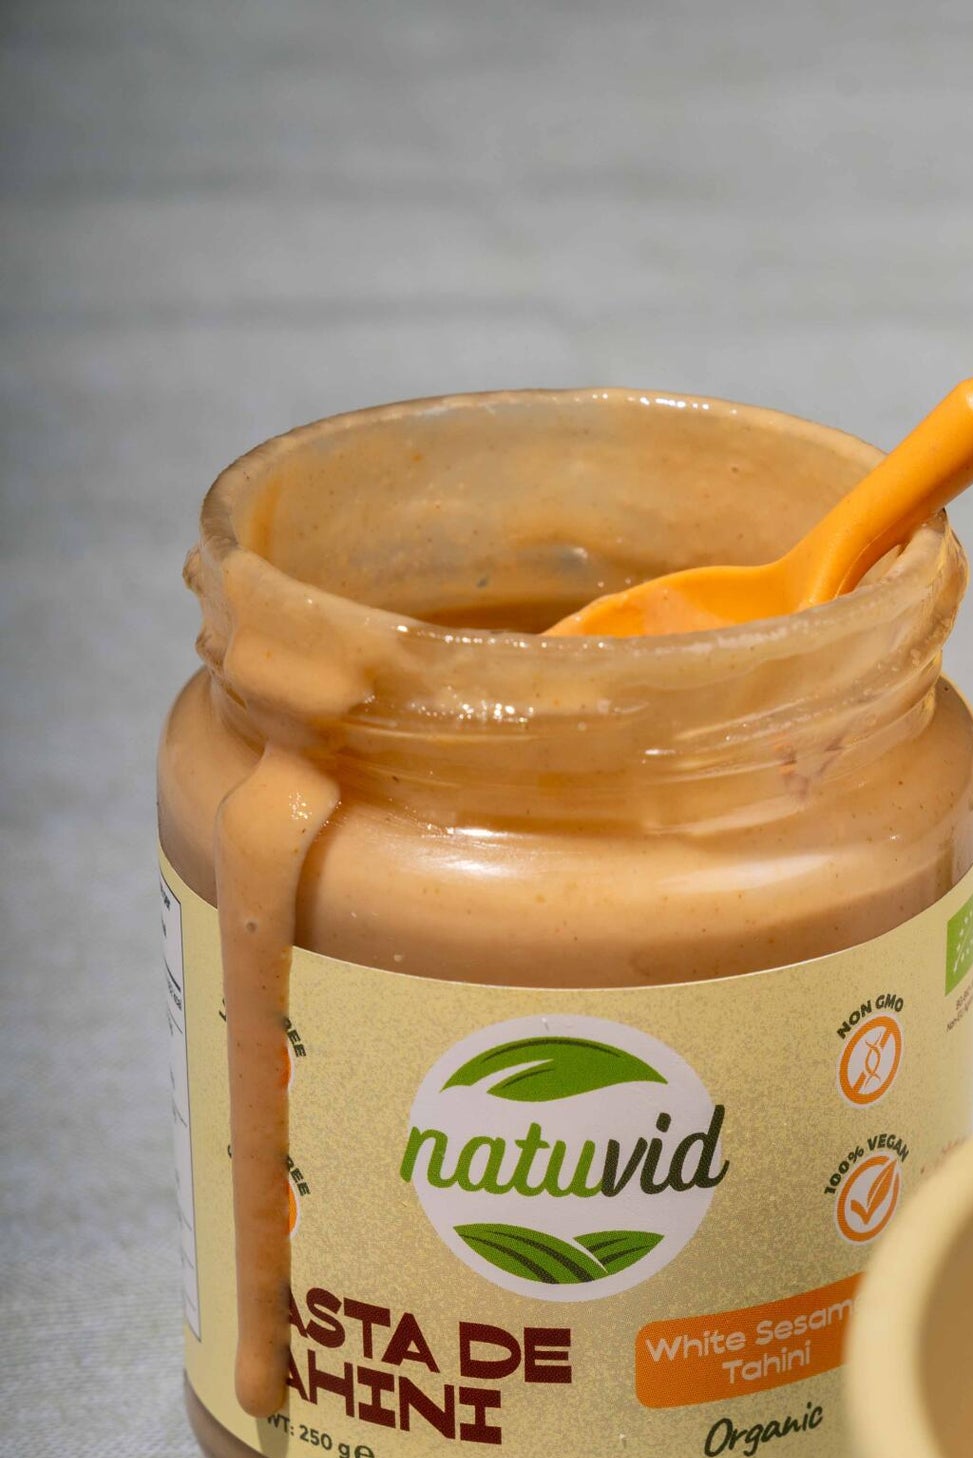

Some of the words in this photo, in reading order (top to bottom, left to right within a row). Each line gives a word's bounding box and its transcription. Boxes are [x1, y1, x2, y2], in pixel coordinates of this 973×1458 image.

[836, 1000, 873, 1039] NON
[875, 993, 904, 1013] GMO
[400, 1104, 729, 1198] natuvid
[824, 1146, 865, 1194] 100%
[867, 1133, 910, 1163] VEGAN
[459, 1321, 572, 1384] DE
[646, 1330, 746, 1362] White
[755, 1297, 857, 1345] Sesam
[722, 1339, 811, 1384] Tahini
[299, 1424, 333, 1451] 250
[704, 1401, 823, 1457] Organic
